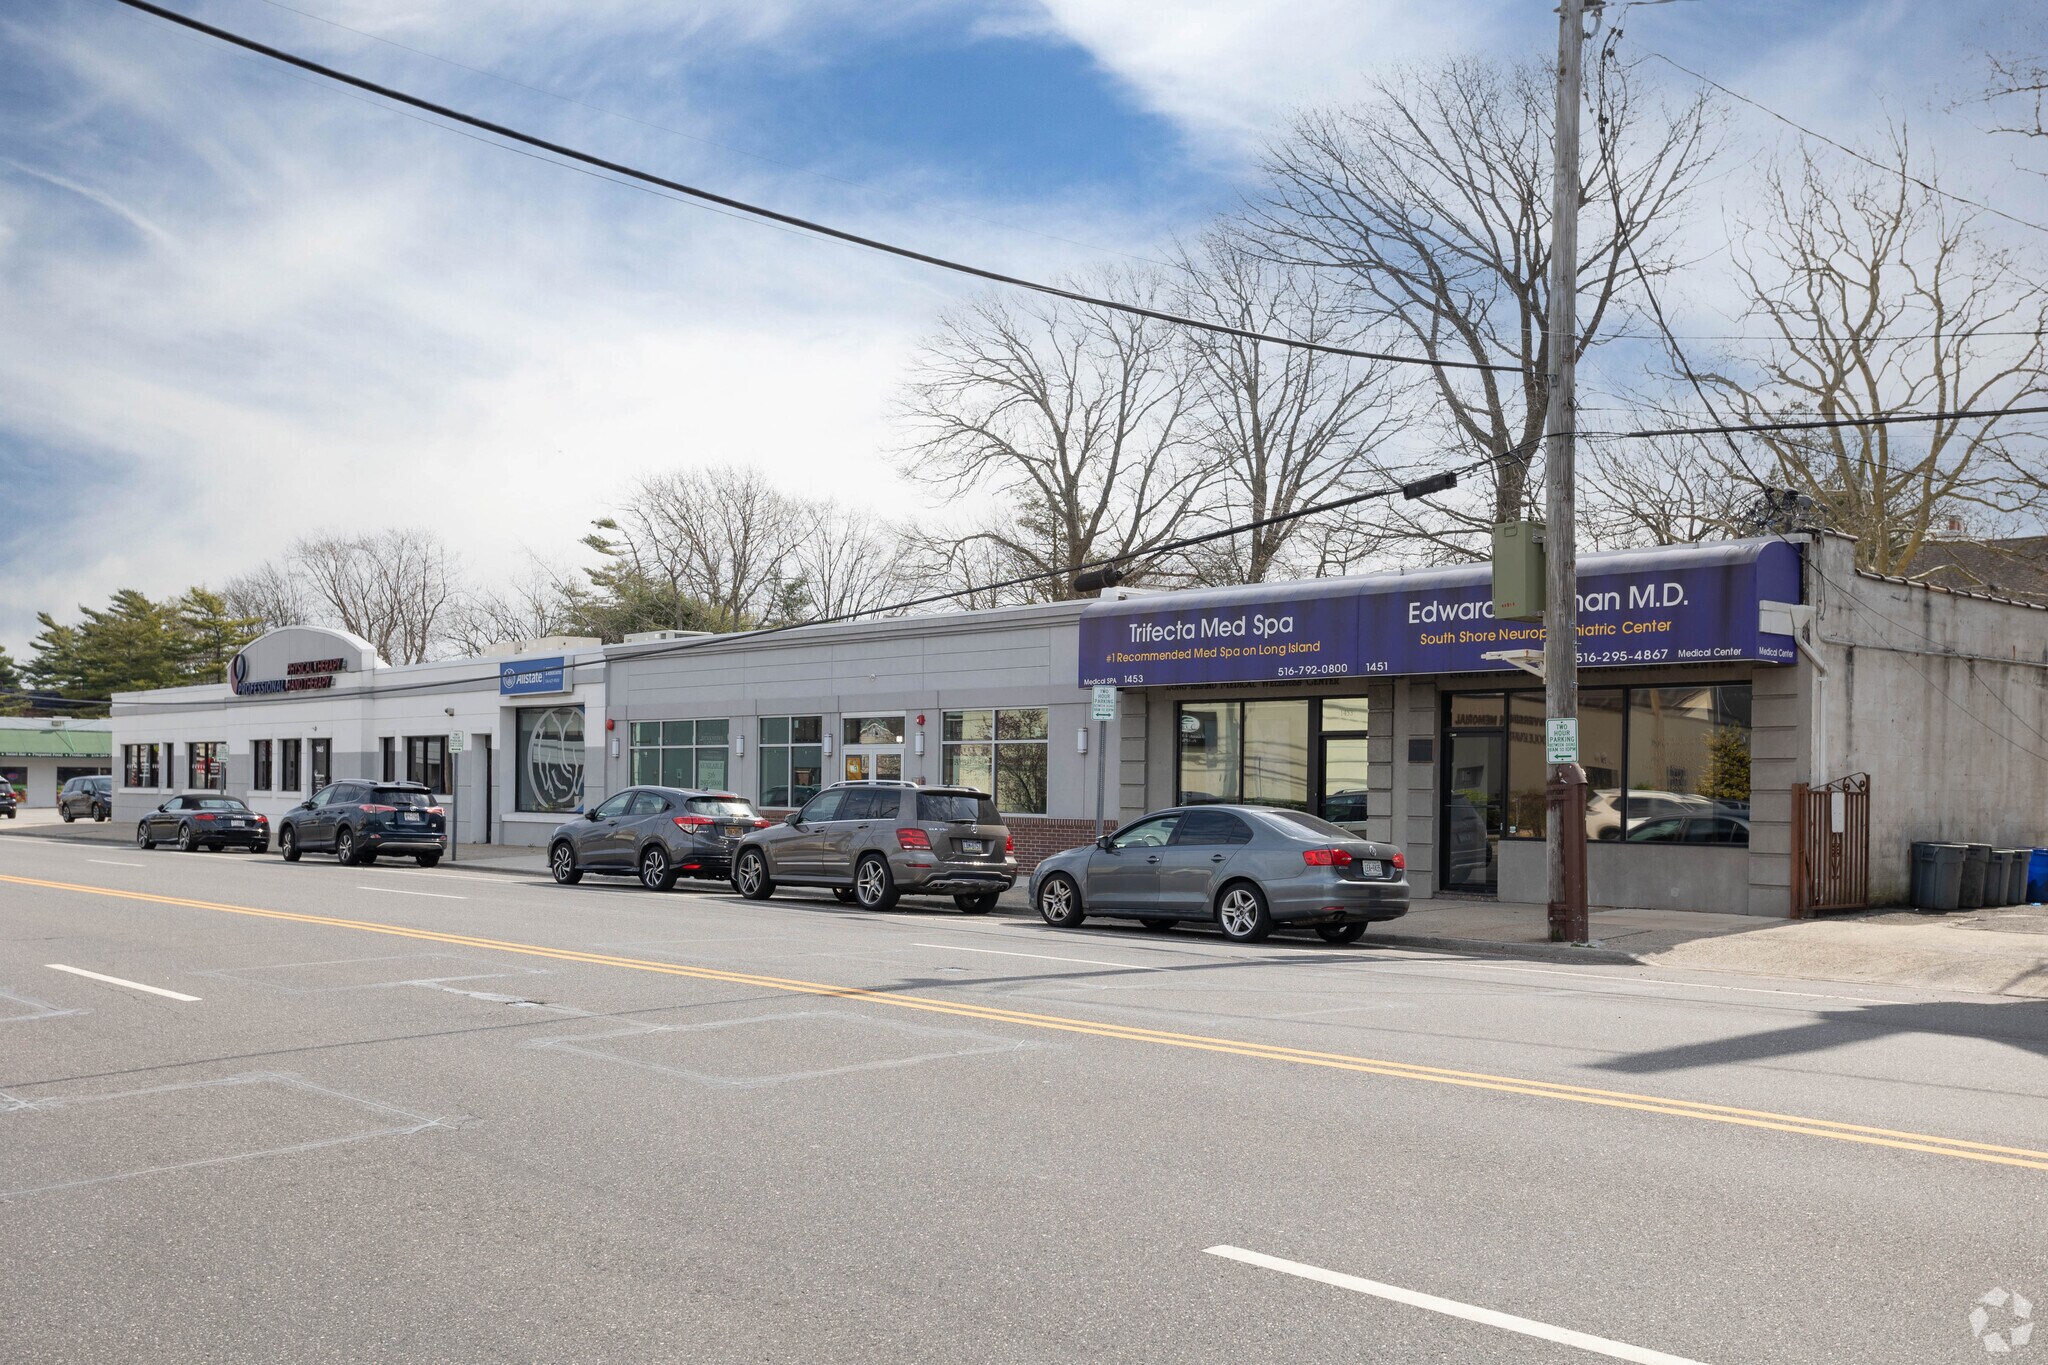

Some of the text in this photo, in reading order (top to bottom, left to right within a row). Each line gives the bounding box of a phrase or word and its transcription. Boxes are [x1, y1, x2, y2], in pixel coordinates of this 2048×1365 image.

[1629, 582, 1689, 609] M.D.
[1129, 613, 1294, 643] Trifecta Med Spa
[1420, 631, 1456, 645] South
[1459, 630, 1497, 643] Shore
[1622, 620, 1672, 634] Center
[1106, 640, 1321, 663] #1 Recommended Med Spa on Long Island
[1576, 649, 1668, 663] 516-295-4867
[1678, 647, 1742, 658] Medical Center
[1759, 646, 1794, 658] Medical Center
[287, 658, 343, 675] PHYSICAL THERAPY
[1277, 663, 1348, 677] 516-792-0800
[1366, 661, 1388, 672] 1451
[237, 680, 287, 695] PROFESSIONAL
[303, 676, 331, 690] THERAPY
[516, 672, 543, 685] Allstate
[1083, 677, 1118, 686] Medical SPA
[1124, 674, 1144, 683] 1453
